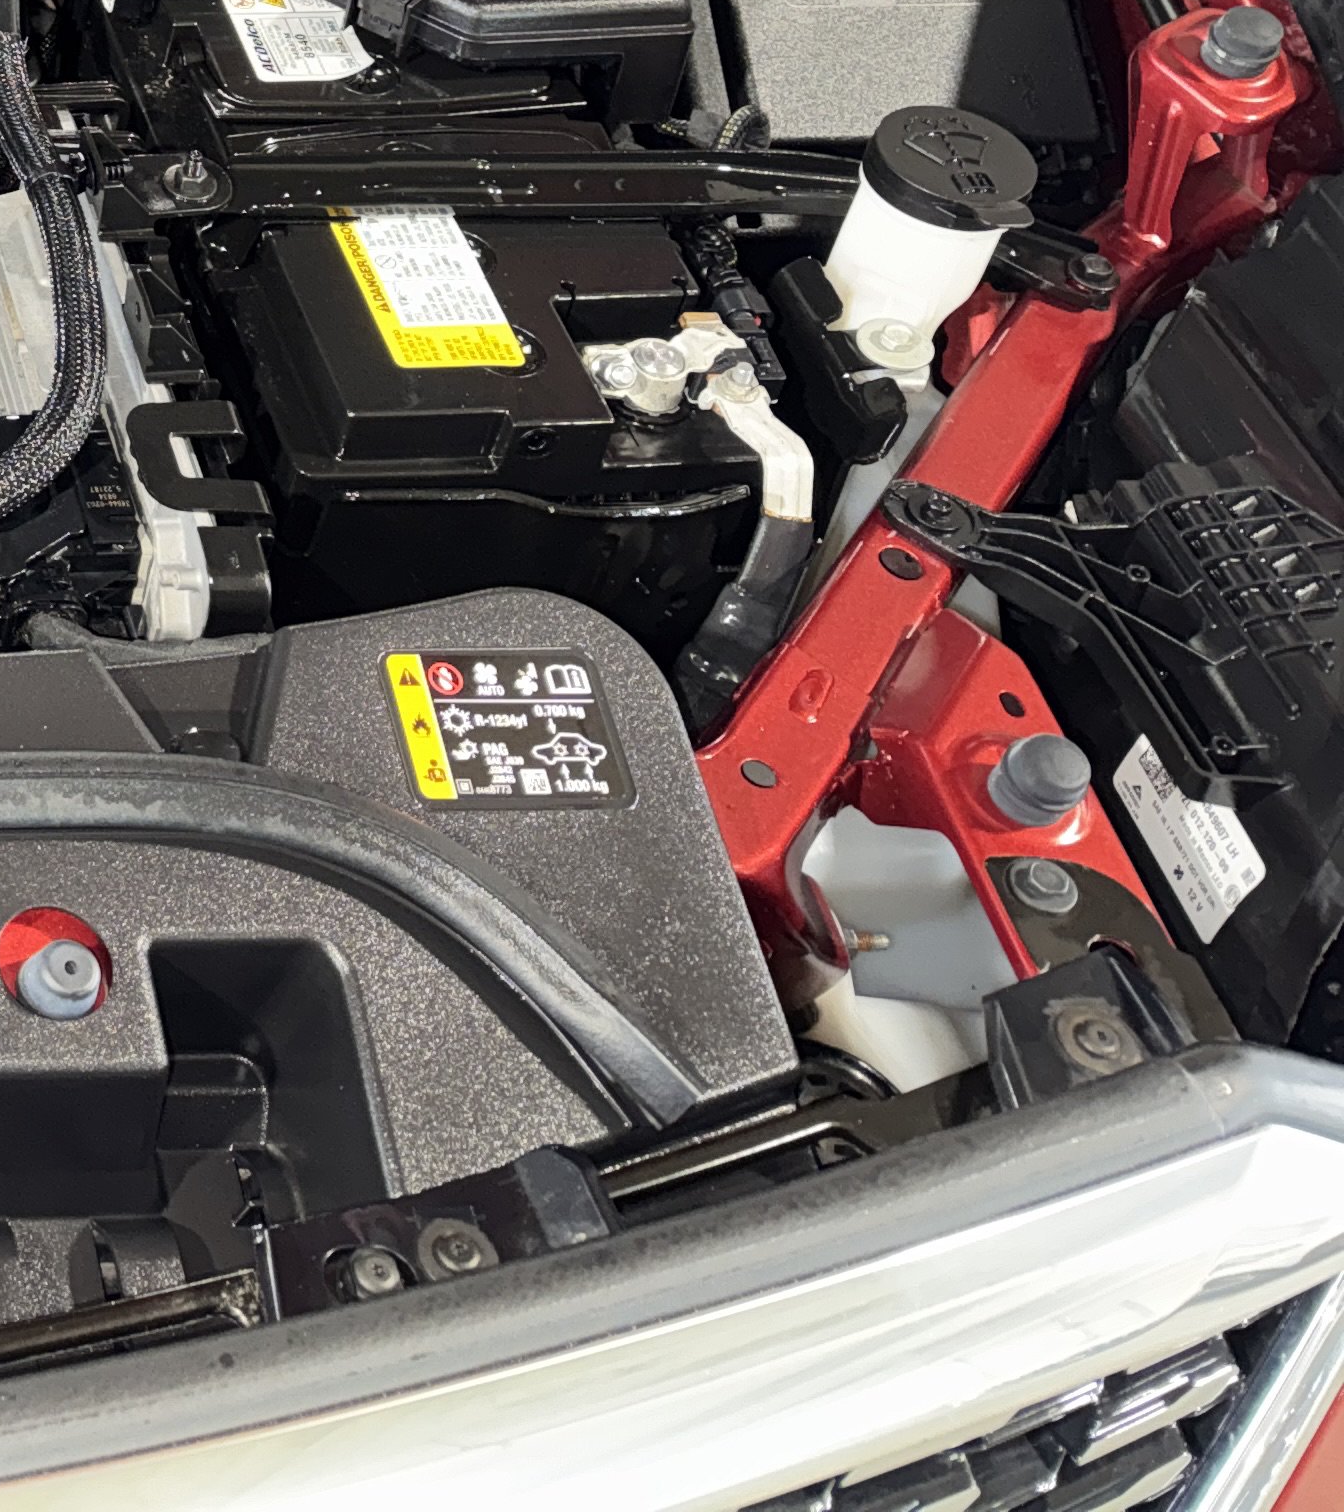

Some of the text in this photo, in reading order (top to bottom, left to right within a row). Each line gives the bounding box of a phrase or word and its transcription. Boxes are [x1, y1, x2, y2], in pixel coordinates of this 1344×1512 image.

[244, 18, 277, 73] ACDelco
[477, 686, 505, 696] AUTO
[568, 705, 585, 719] kg
[482, 743, 508, 755] PAG
[556, 779, 609, 794] 1.000 kg
[1224, 842, 1240, 859] LH
[1184, 887, 1198, 902] 12
